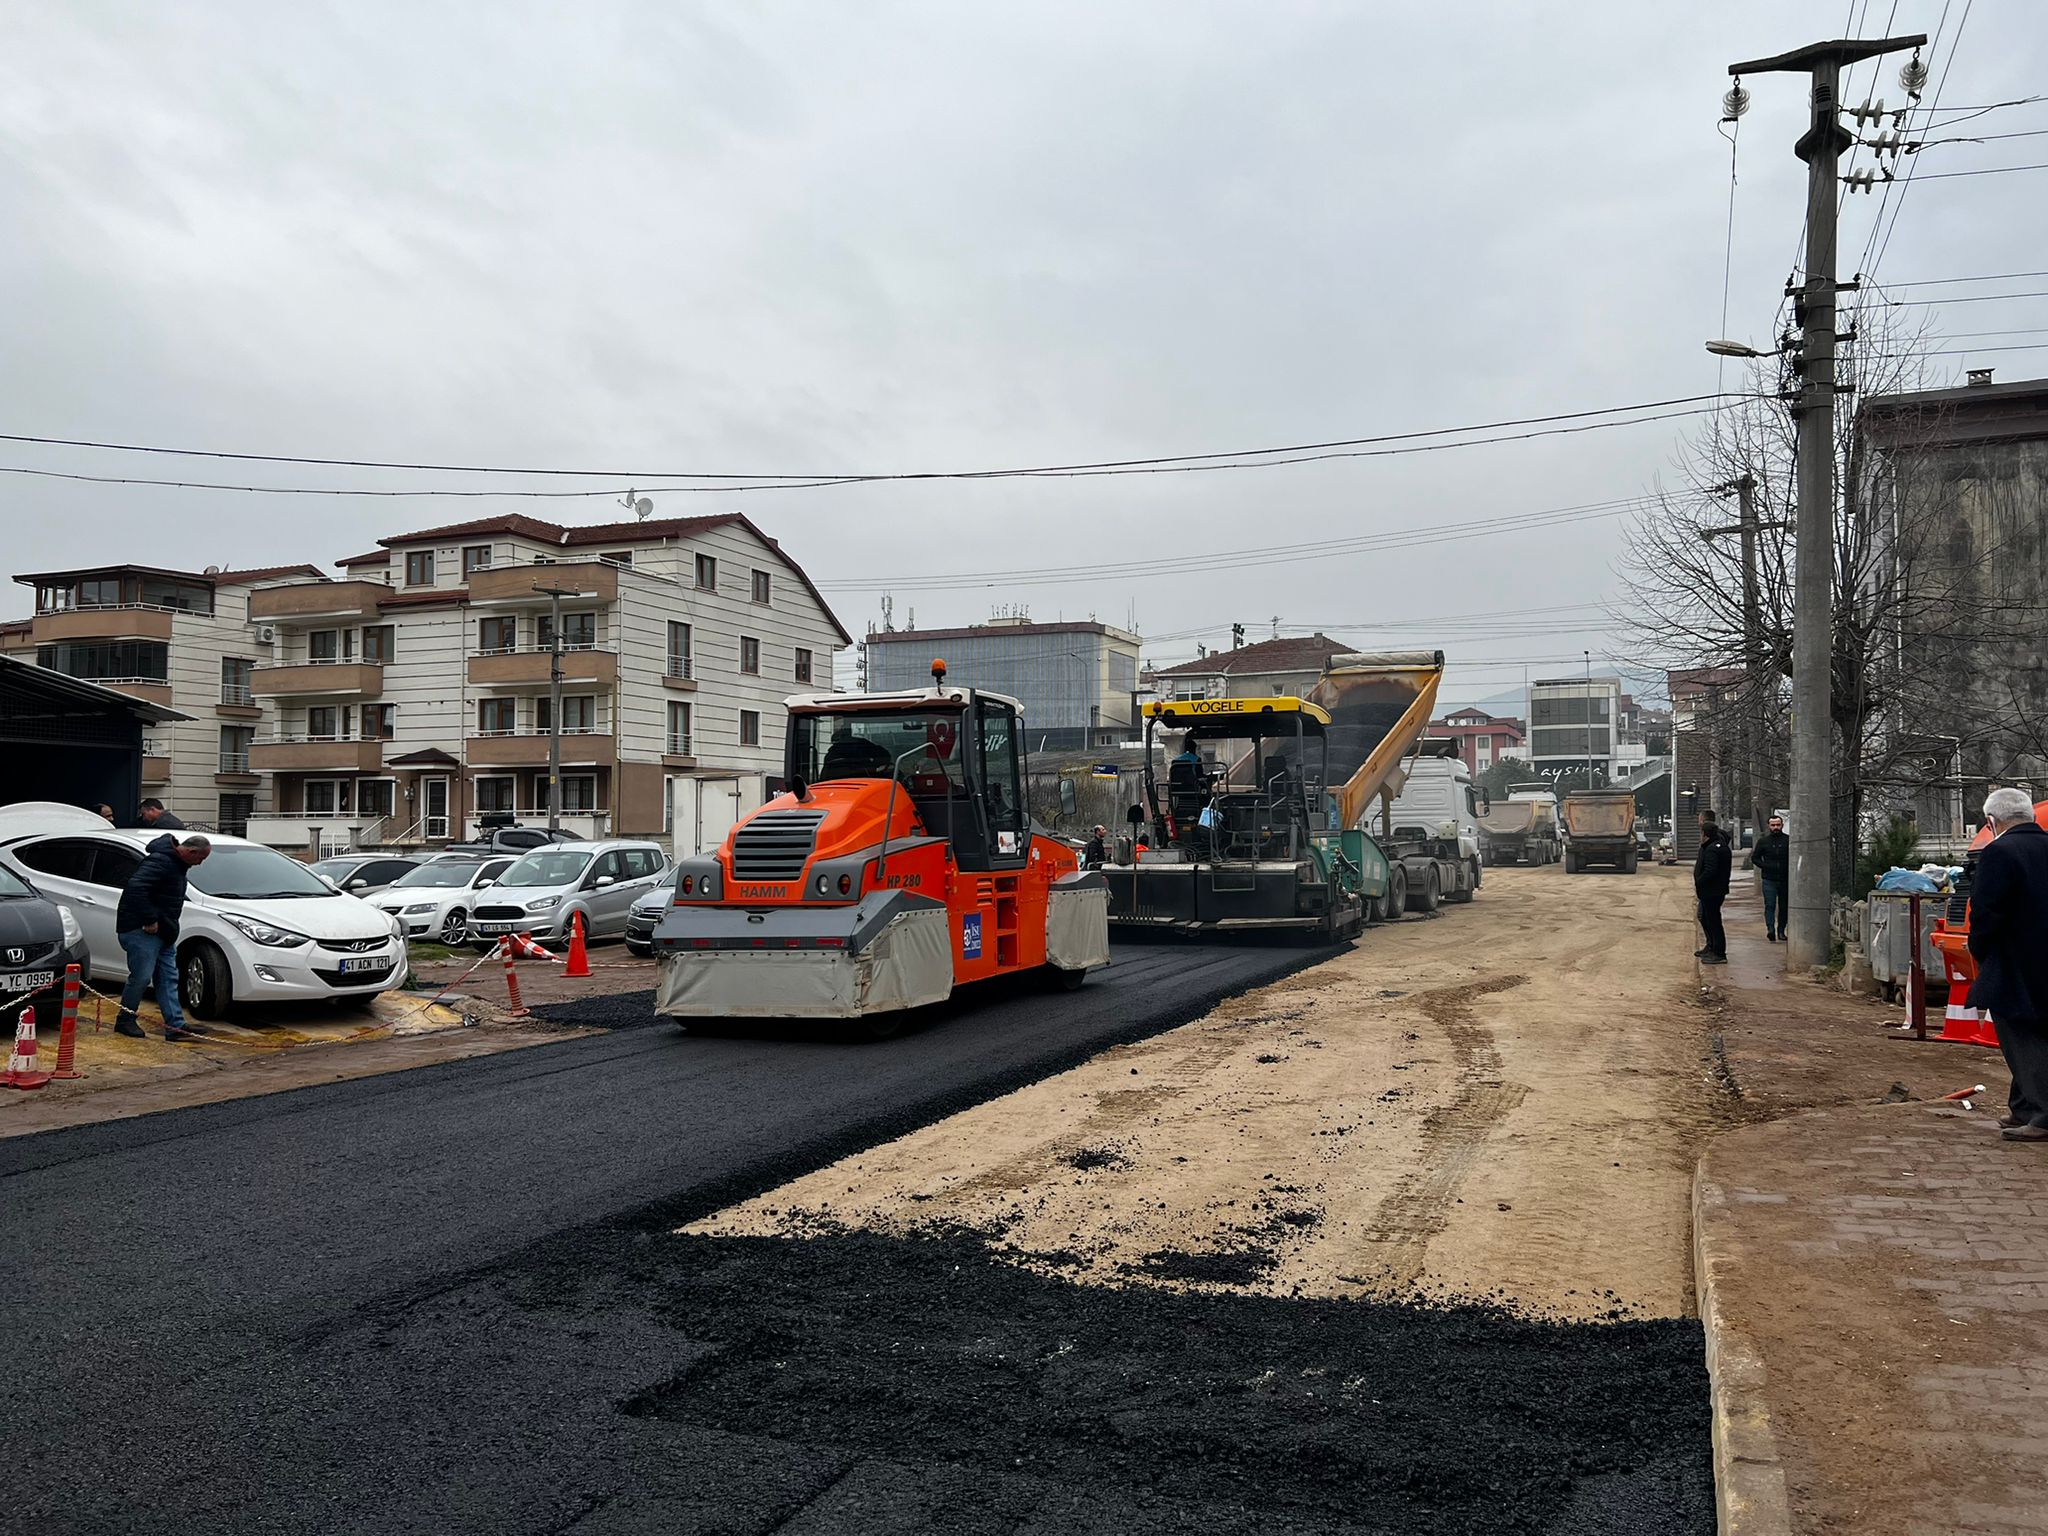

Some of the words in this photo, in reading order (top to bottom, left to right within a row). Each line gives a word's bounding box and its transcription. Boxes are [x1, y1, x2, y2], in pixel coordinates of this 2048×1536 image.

[888, 875, 901, 889] HP
[903, 873, 921, 888] 280
[740, 885, 786, 898] HAMM
[346, 960, 354, 971] 41
[377, 958, 387, 969] 121
[9, 975, 22, 988] YC
[27, 972, 52, 987] 0995
